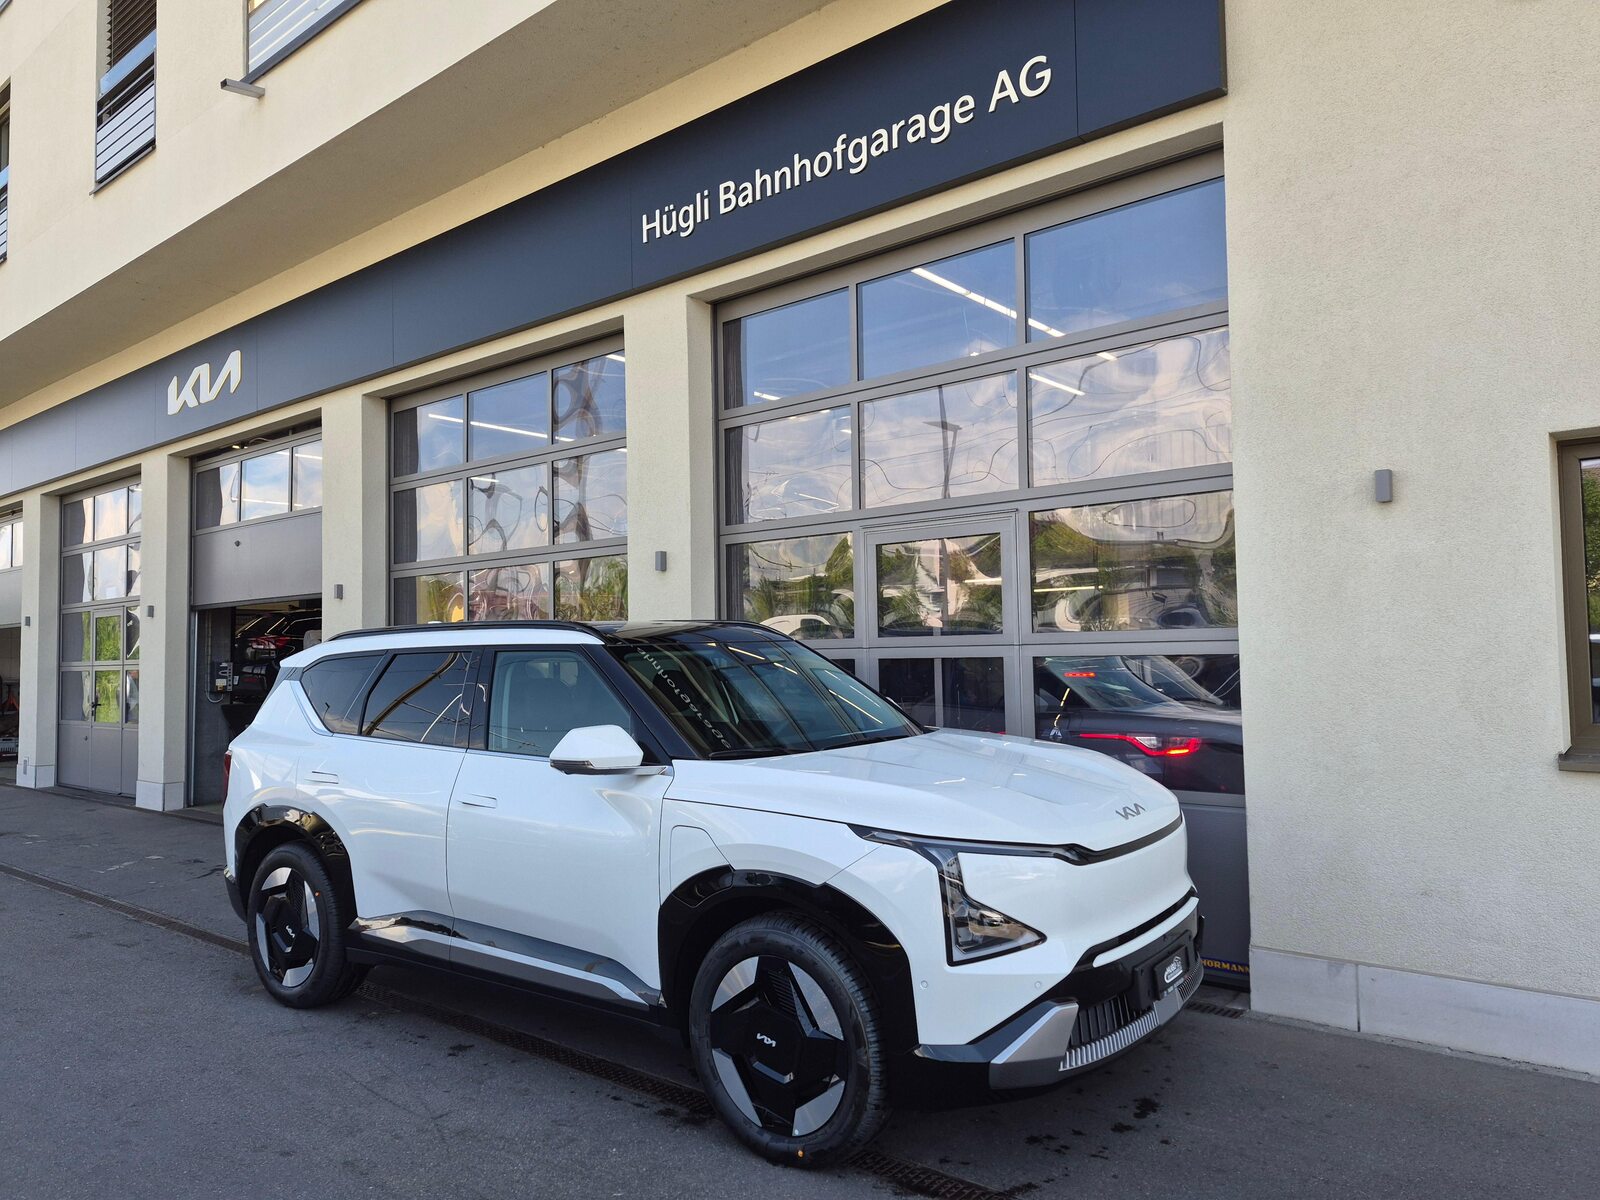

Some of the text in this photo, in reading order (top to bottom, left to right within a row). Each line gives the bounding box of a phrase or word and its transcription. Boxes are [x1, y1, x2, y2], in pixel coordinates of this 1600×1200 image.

[641, 55, 1053, 242] Hügli Bahnhofgarage AG
[167, 350, 242, 416] KIA
[1115, 803, 1146, 820] KIA
